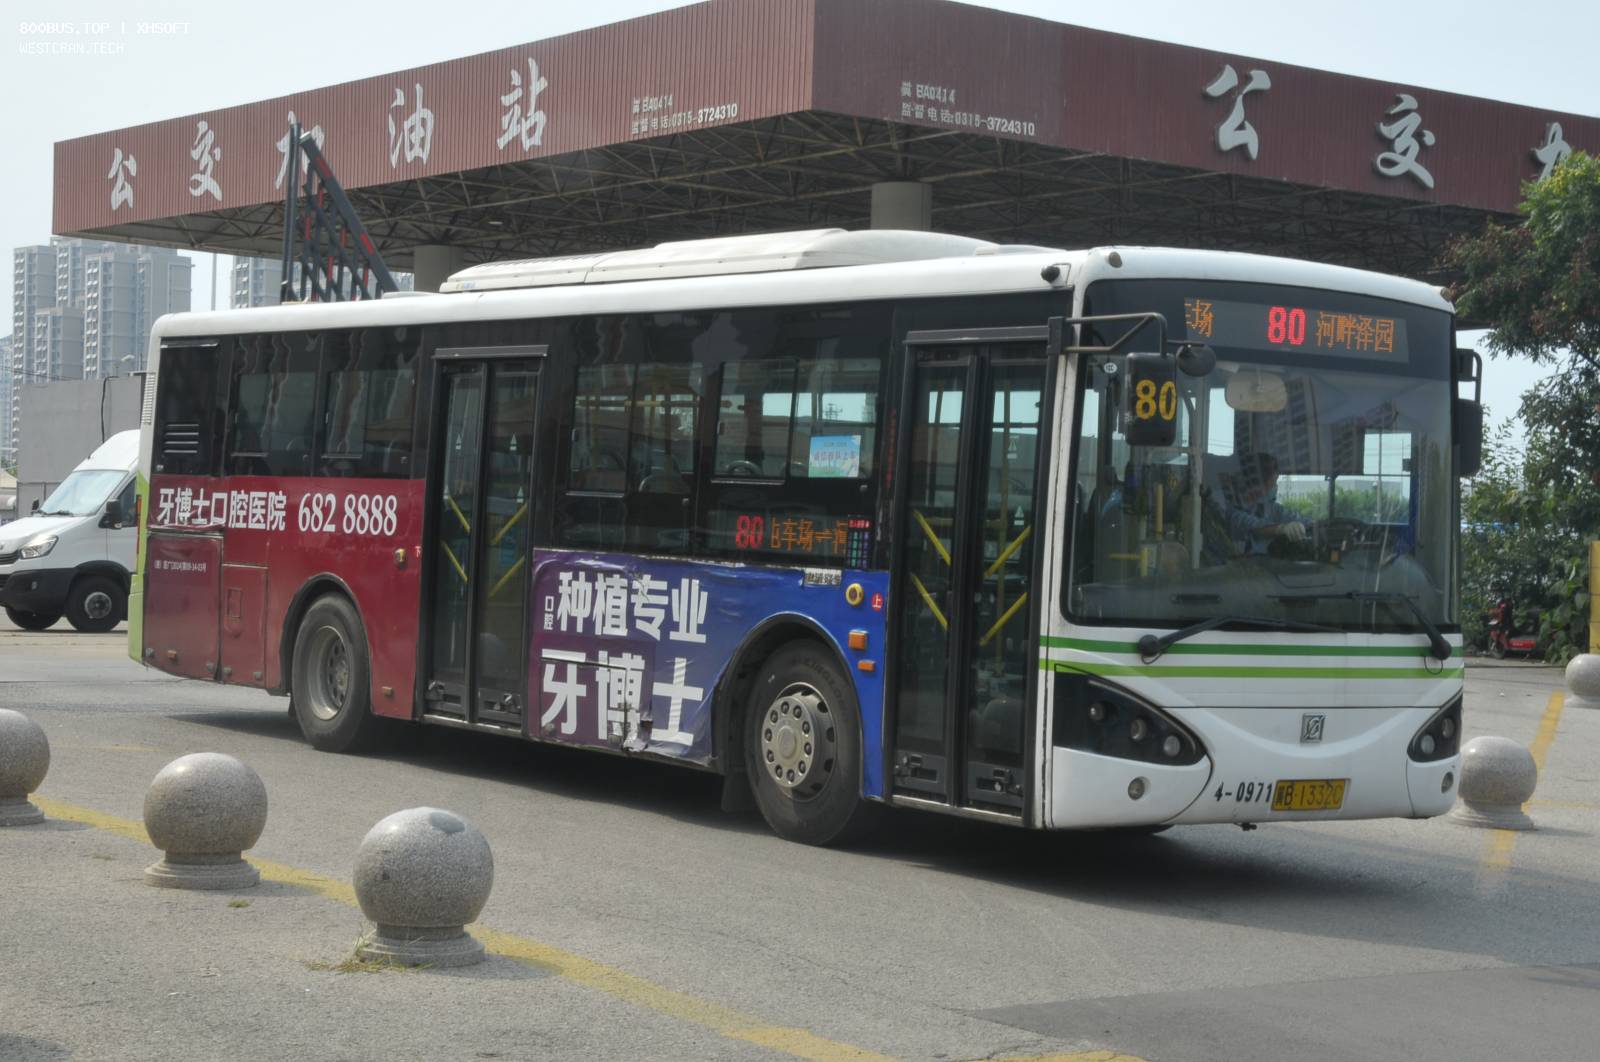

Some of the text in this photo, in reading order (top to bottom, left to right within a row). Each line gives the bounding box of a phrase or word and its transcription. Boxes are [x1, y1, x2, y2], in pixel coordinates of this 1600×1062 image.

[1267, 306, 1306, 345] 80
[1136, 379, 1176, 421] 80
[156, 487, 397, 536] 牙博士口腔医院 682 8888
[736, 514, 764, 549] 80
[556, 570, 709, 643] 种植专业
[872, 593, 883, 609] 上
[541, 648, 704, 747] 牙博士
[1214, 781, 1273, 802] 4-0971
